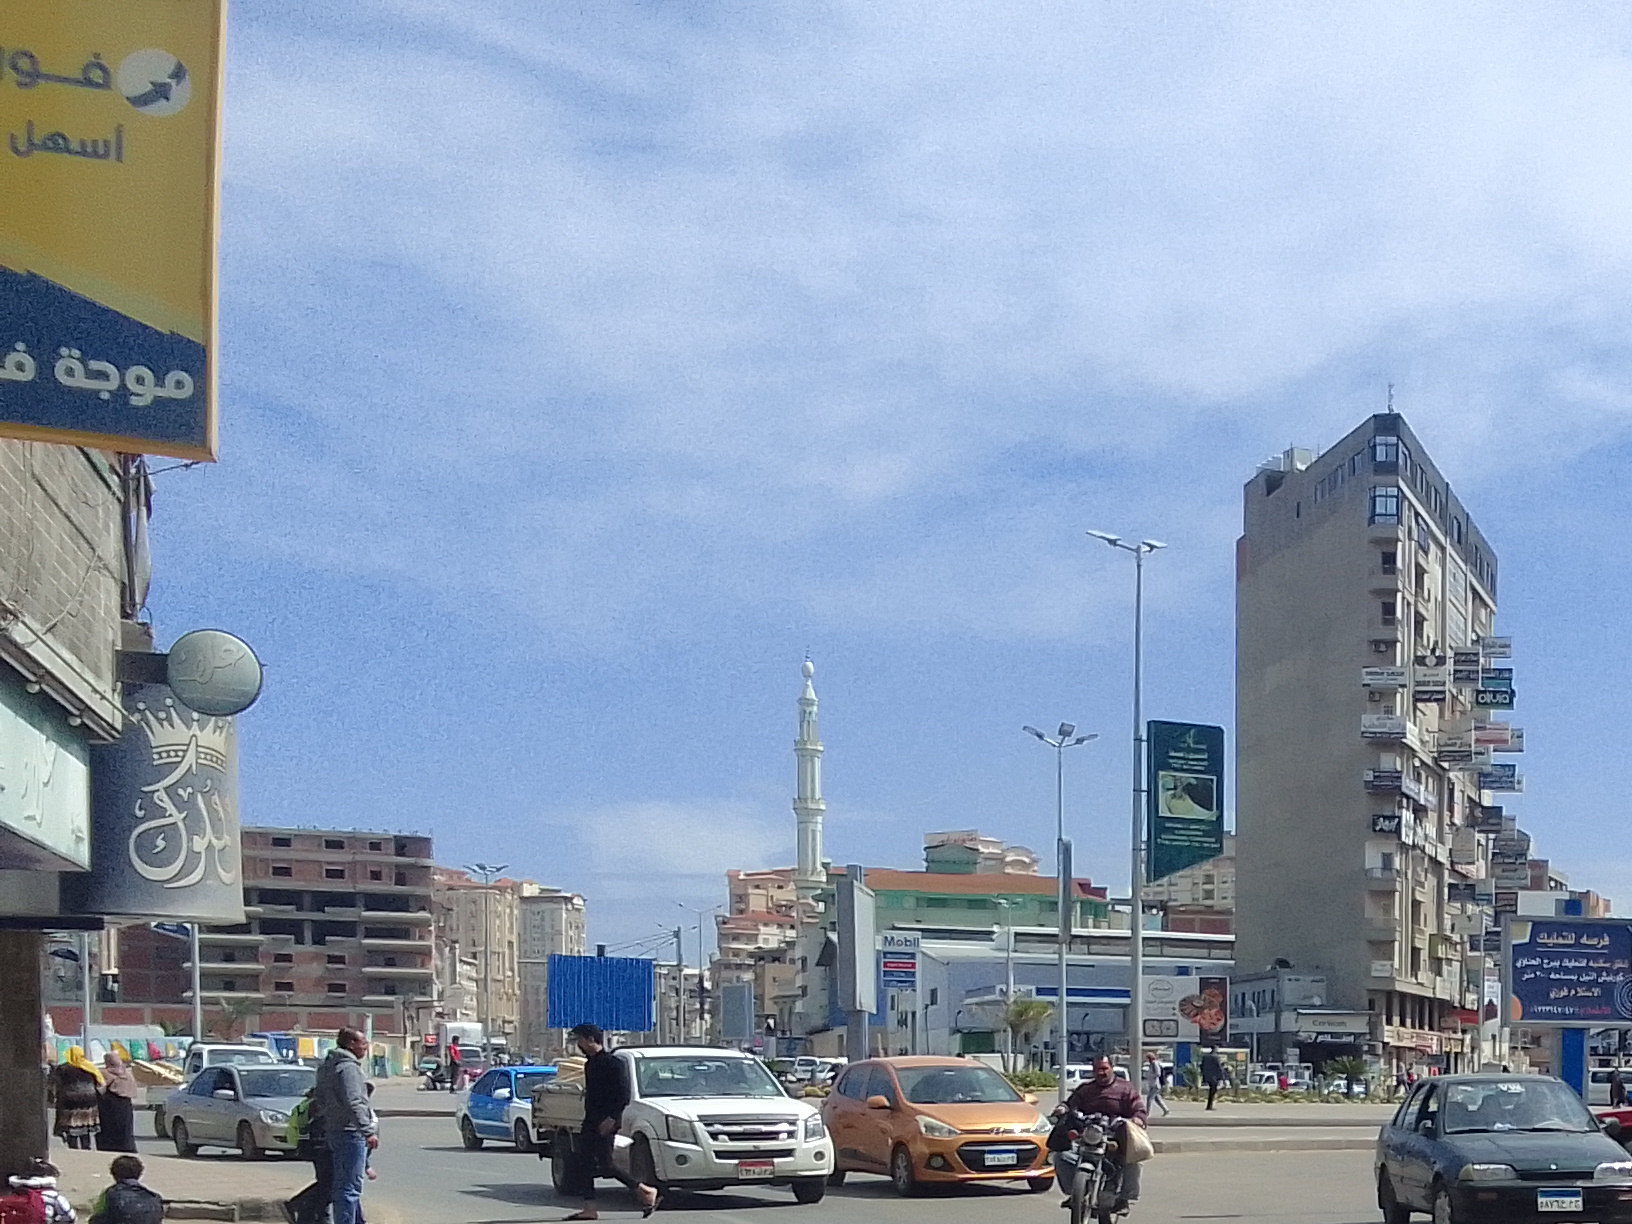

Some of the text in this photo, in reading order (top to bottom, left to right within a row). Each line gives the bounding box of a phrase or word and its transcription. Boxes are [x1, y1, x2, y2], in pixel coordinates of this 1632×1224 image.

[54, 346, 195, 406] موجة
[884, 935, 920, 948] Mobil
[1536, 931, 1575, 947] للتمليك
